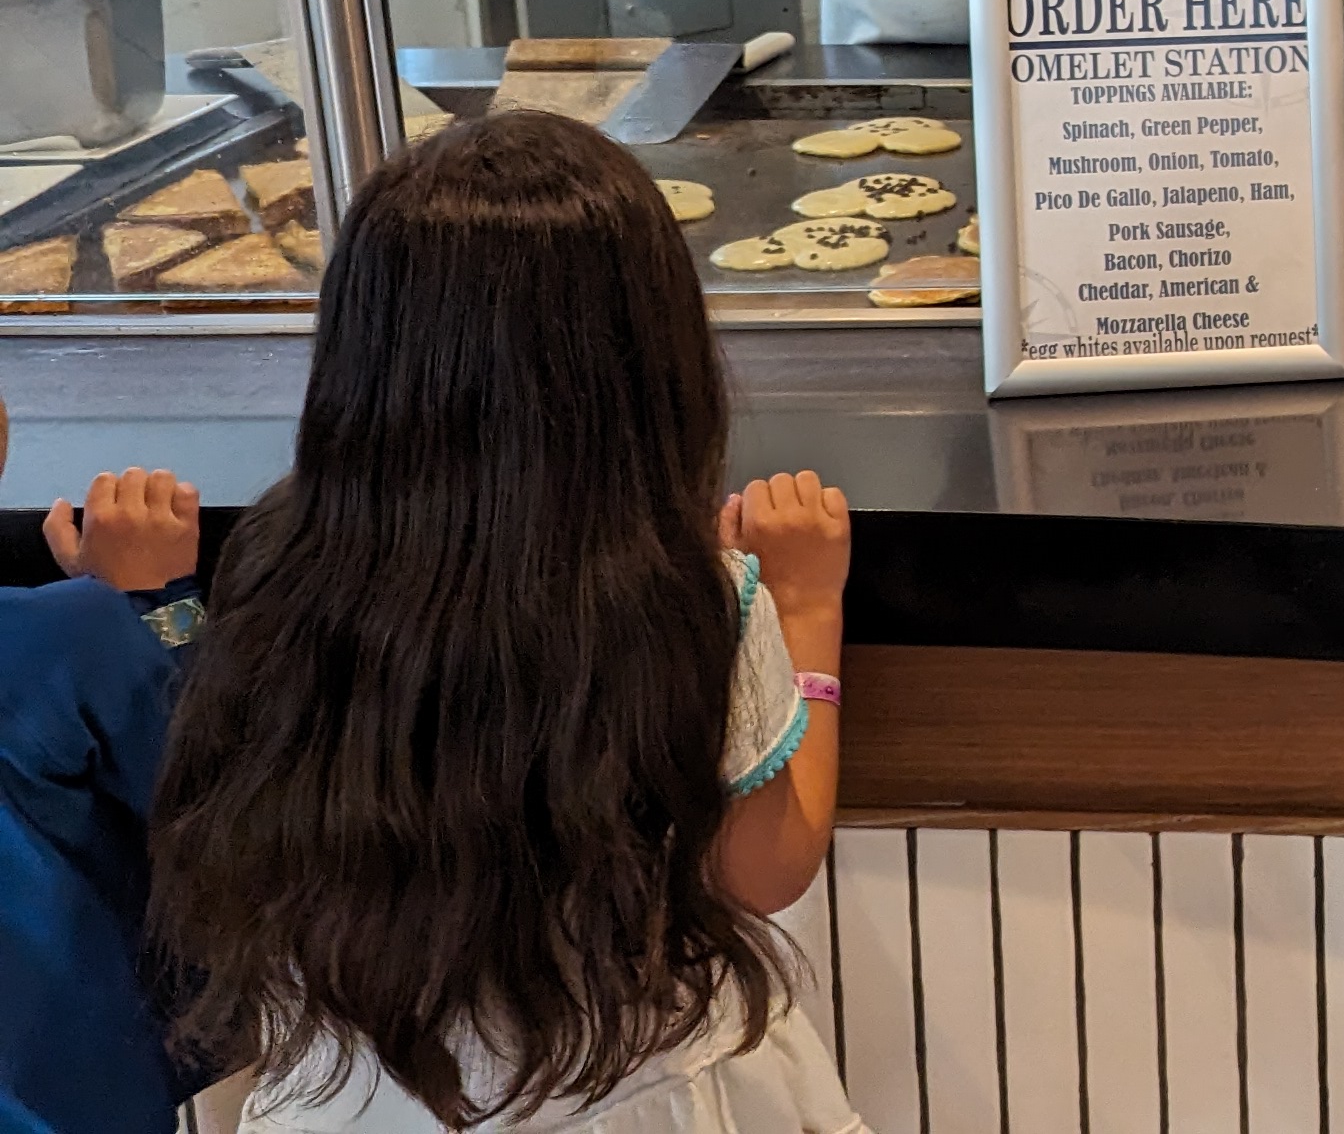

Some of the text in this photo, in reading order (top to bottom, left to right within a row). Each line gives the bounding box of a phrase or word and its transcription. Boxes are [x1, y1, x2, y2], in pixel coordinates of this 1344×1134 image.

[1011, 44, 1310, 83] OMELET STATION
[1070, 80, 1253, 105] TOPPINGS AVAILABLE:
[1062, 116, 1263, 142] Spinach, Green Pepper,
[1048, 148, 1279, 175] Mushroom, Onion, Tomato,
[1034, 182, 1295, 210] Pico De Gallo, Jalapeno, Ham,
[1108, 218, 1231, 242] Pork Sausage,
[1103, 247, 1232, 272] Bacon, Chorizo
[1078, 274, 1260, 302] Cheddar, American &
[1096, 311, 1250, 336] Mozzarella Cheese
[1063, 335, 1119, 358] whites
[1123, 330, 1199, 355] available
